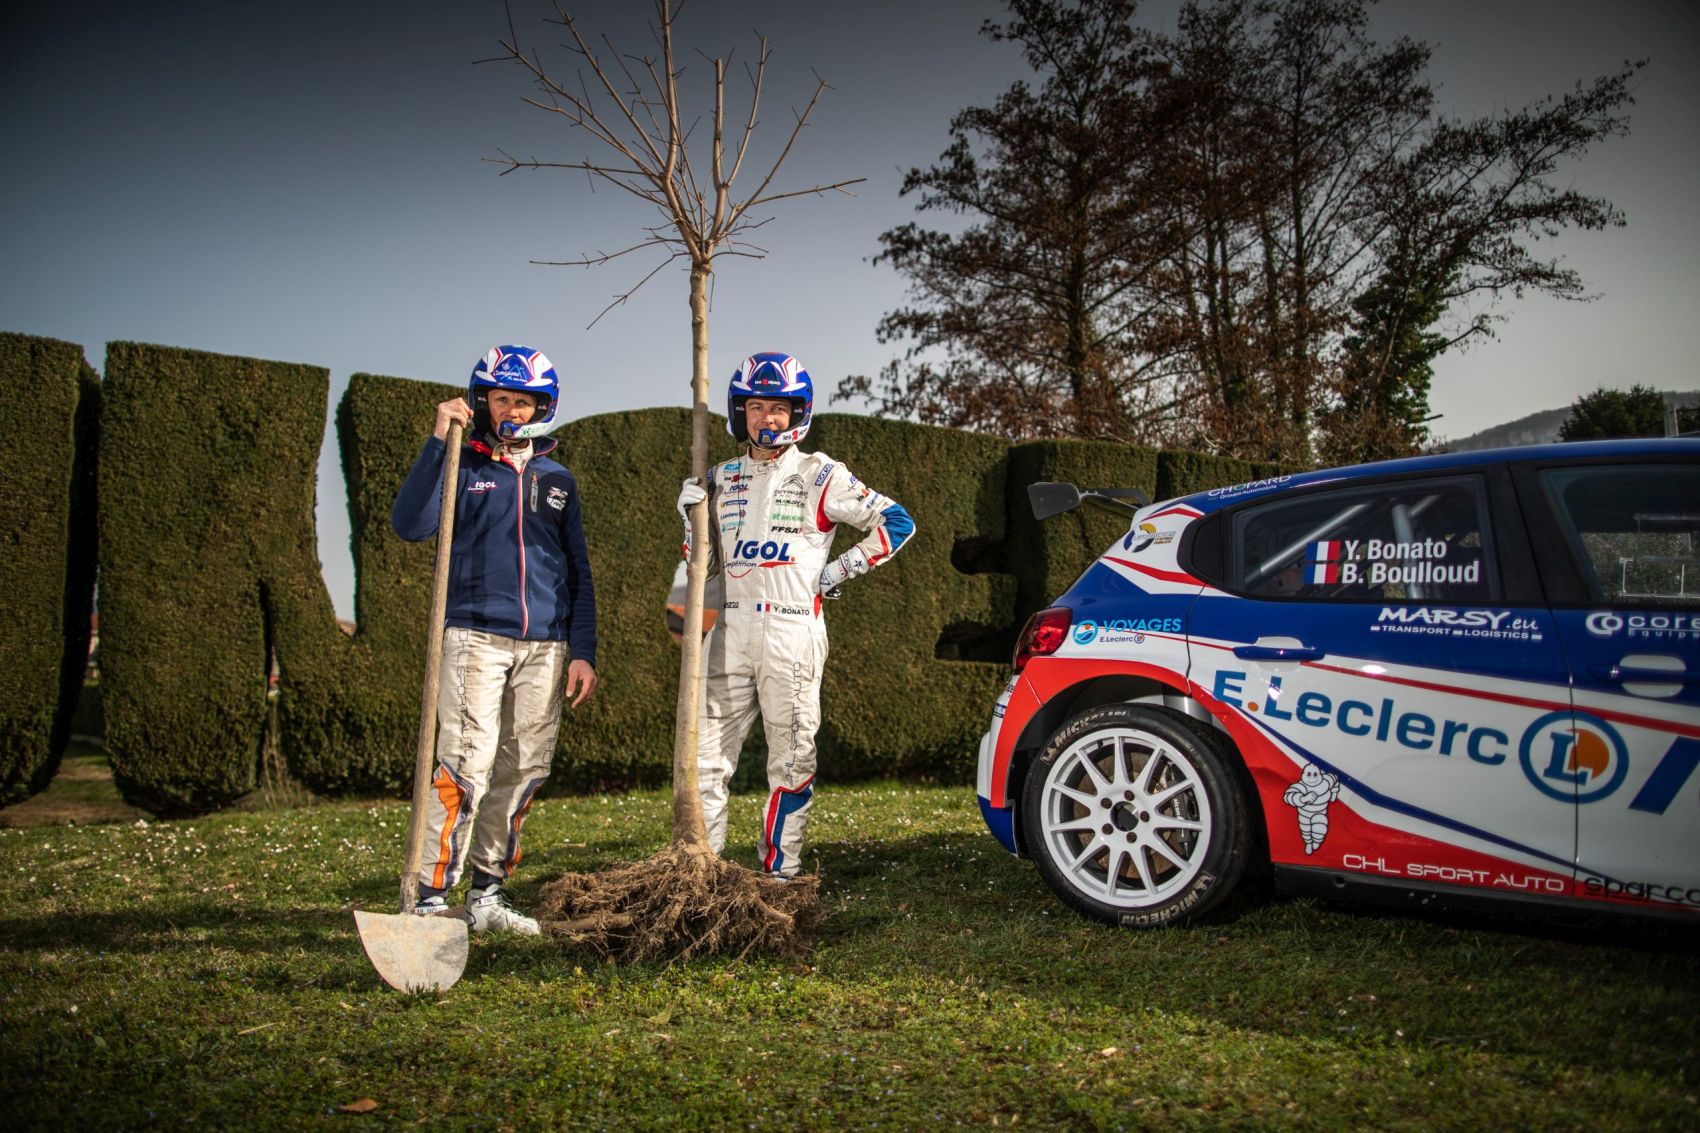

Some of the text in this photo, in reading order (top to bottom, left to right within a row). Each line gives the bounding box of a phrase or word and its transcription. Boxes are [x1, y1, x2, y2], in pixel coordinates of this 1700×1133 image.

[1208, 475, 1292, 497] CHOPARD
[771, 526, 798, 534] FFSA
[1345, 538, 1447, 561] Y. Bonato
[1342, 560, 1479, 584] B. Boulloud
[1103, 618, 1182, 632] VOYAGES
[1382, 625, 1529, 640] TRANSPORT LOGISTICS
[1100, 634, 1134, 643] E.Leclerc
[1213, 669, 1509, 766] E.Leclerc
[1343, 854, 1564, 892] CHL SPORT AUTO
